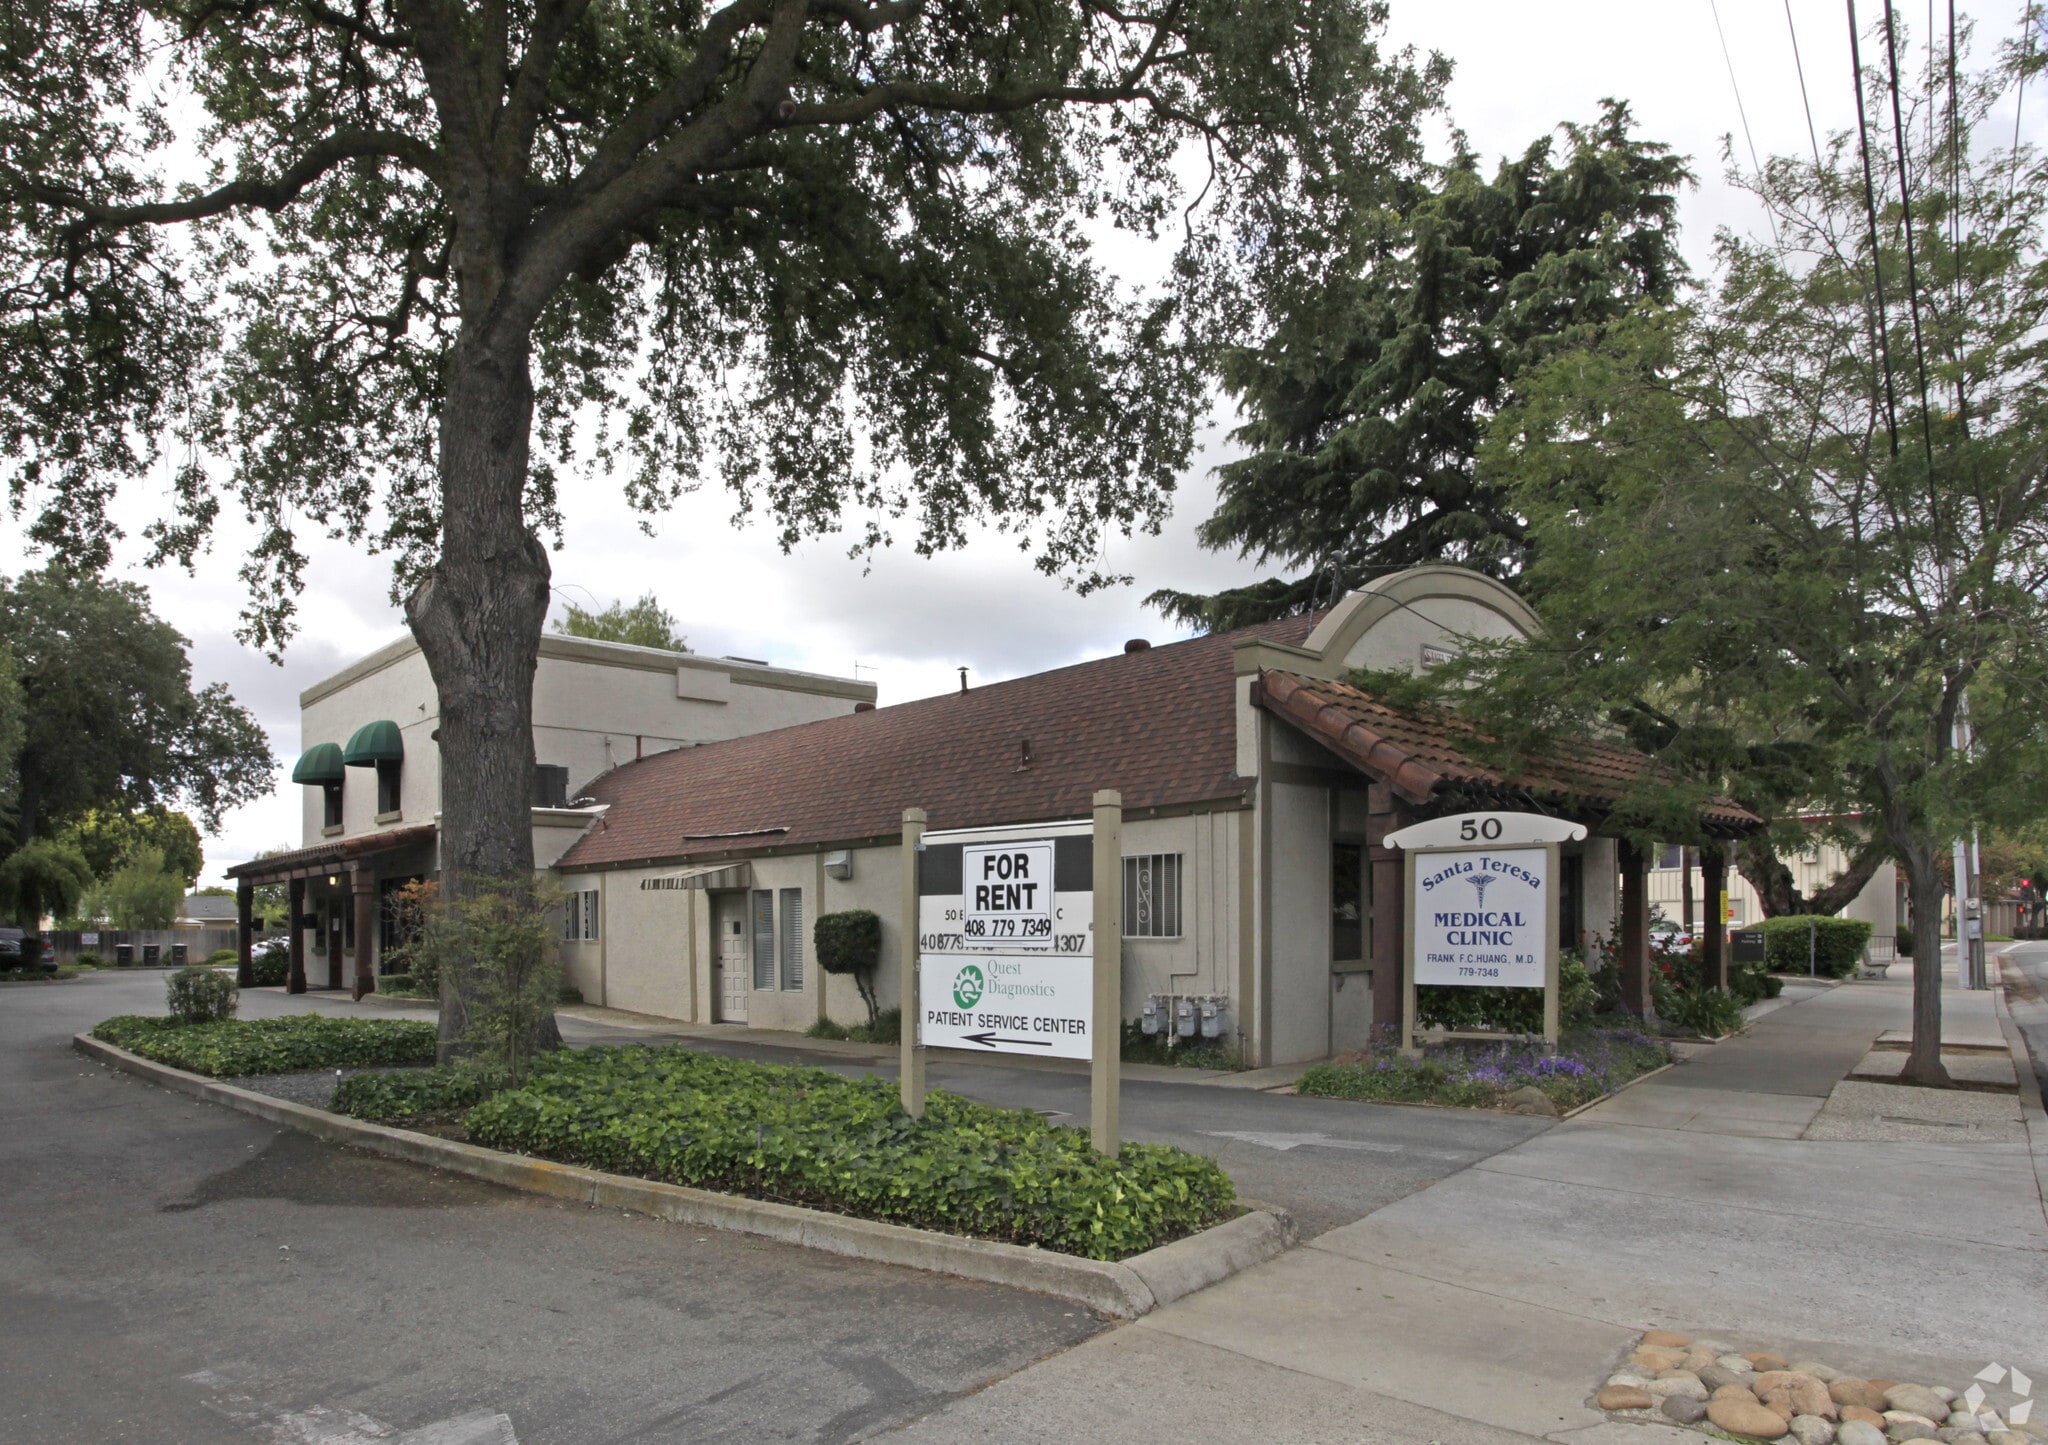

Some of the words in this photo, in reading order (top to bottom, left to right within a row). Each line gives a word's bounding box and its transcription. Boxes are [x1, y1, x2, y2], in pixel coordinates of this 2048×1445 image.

[1460, 818, 1503, 841] 50
[983, 853, 1030, 881] FOR
[1422, 860, 1474, 892] Santa
[1479, 857, 1541, 890] Teresa
[975, 883, 1038, 911] RENT
[944, 909, 957, 921] 50
[1434, 912, 1526, 927] MEDICAL
[964, 919, 986, 937] 408
[991, 919, 1016, 937] 779
[1021, 918, 1051, 937] 7349
[1446, 930, 1514, 946] CLINIC
[1427, 953, 1455, 964] FRANK
[1515, 953, 1537, 964] M.D.
[987, 959, 1022, 978] Quest
[1458, 966, 1499, 978] 779-7348
[988, 979, 1055, 999] Diagnostics
[927, 1010, 974, 1027] PATIENT
[977, 1014, 1029, 1031] SERVICE
[1033, 1017, 1086, 1035] CENTER
